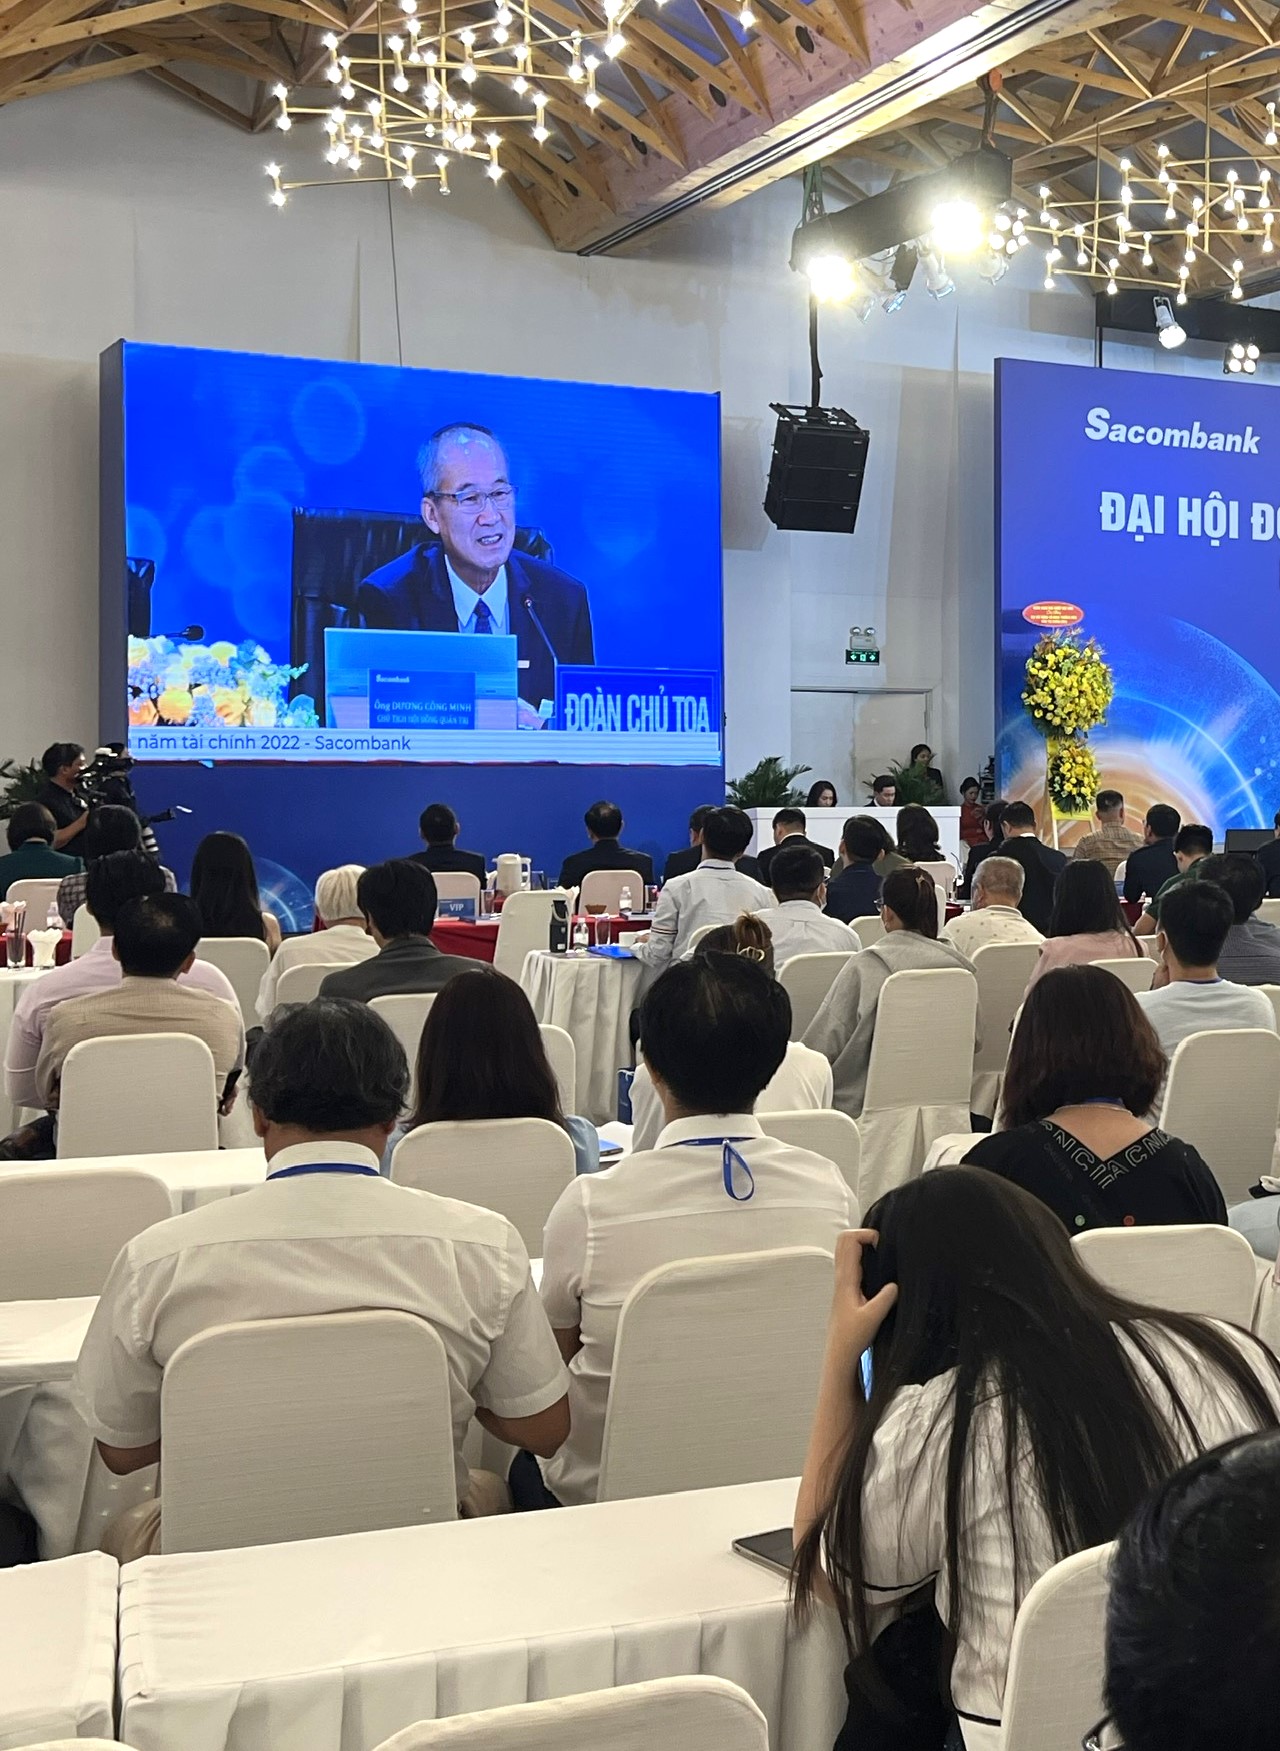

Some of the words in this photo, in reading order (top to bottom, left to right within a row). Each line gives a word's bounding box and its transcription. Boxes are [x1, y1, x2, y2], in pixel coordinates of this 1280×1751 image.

[1084, 406, 1261, 454] Sacombank
[1099, 490, 1165, 542] ĐẠI
[1177, 490, 1239, 546] HỘI
[449, 702, 471, 712] MINH
[564, 686, 621, 732] ĐOÀN
[627, 685, 669, 732] CHỦ
[138, 735, 176, 750] năm
[182, 734, 203, 750] tài
[208, 734, 256, 750] chính
[261, 735, 300, 750] 2022
[315, 734, 411, 751] Sacombank
[449, 903, 464, 912] VIP
